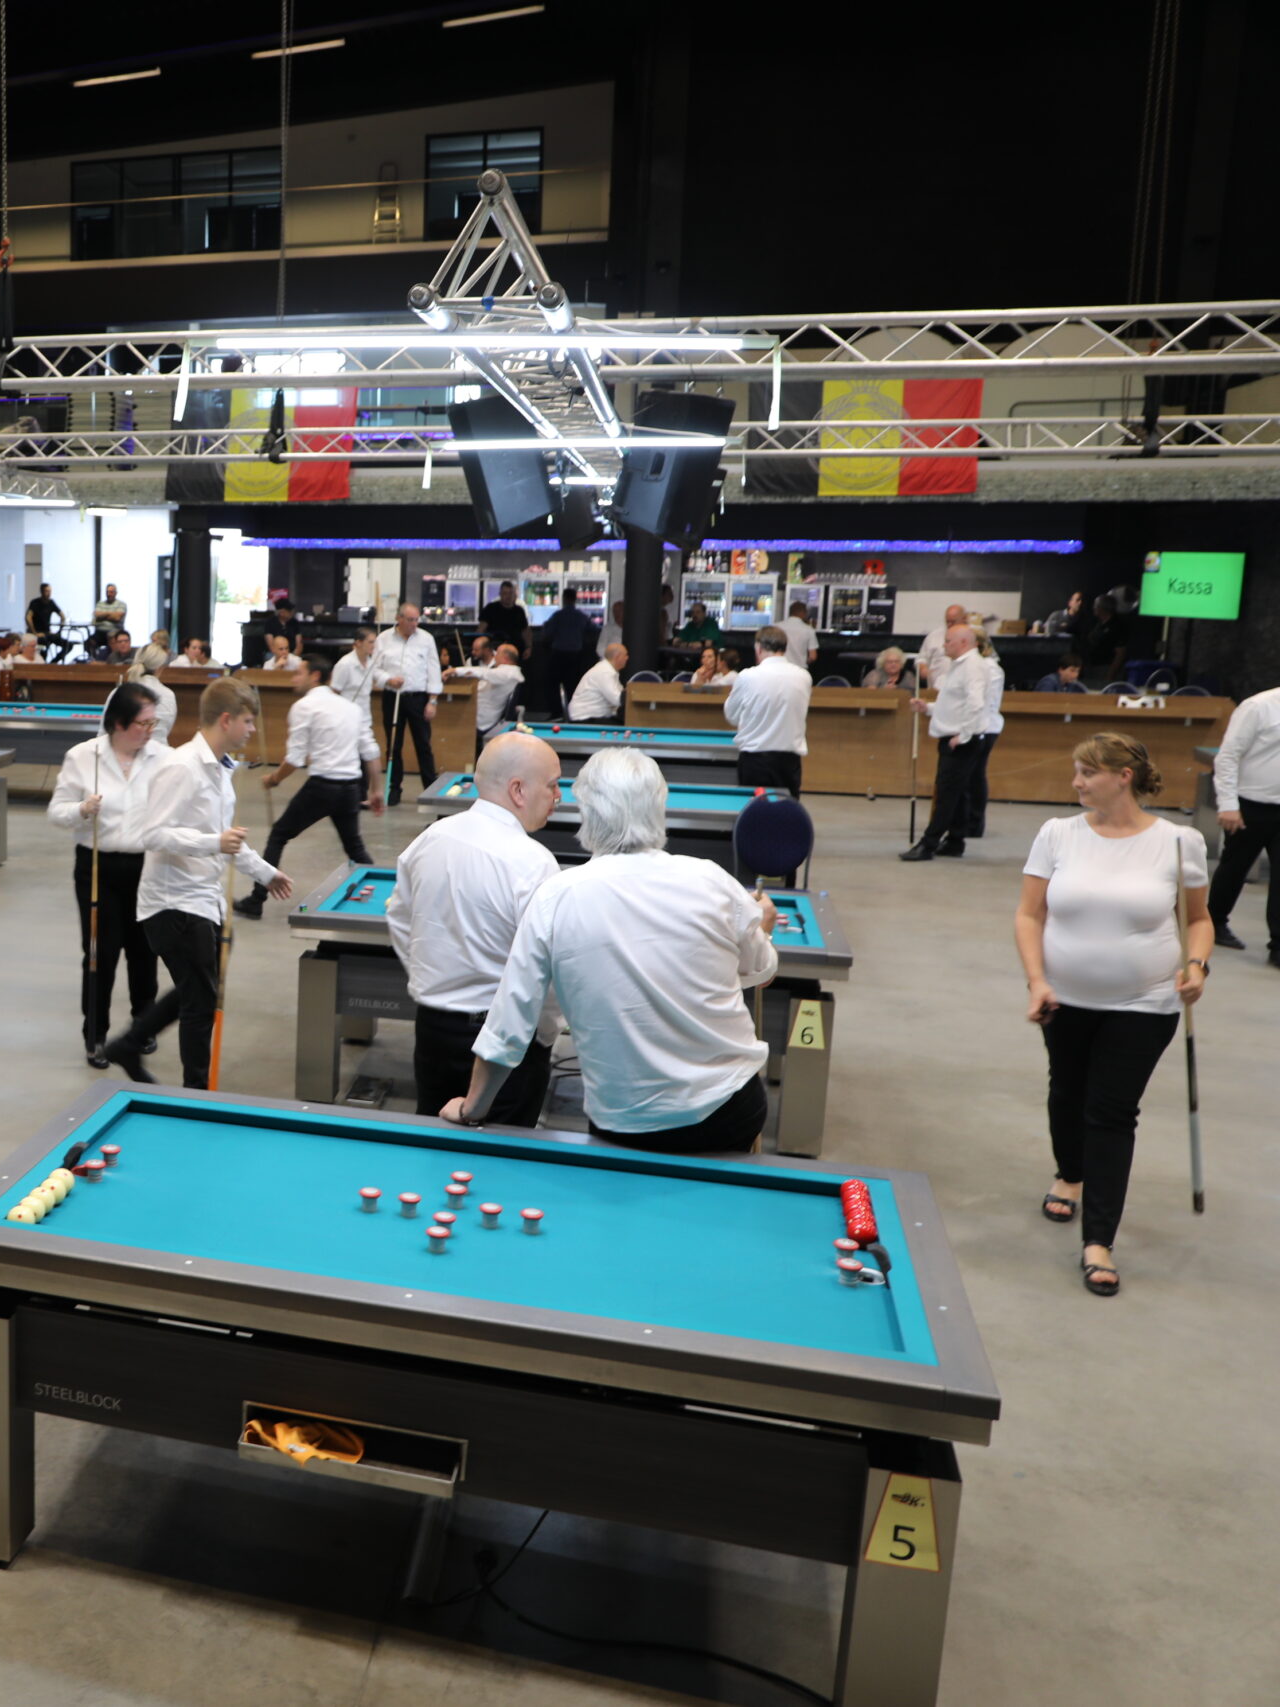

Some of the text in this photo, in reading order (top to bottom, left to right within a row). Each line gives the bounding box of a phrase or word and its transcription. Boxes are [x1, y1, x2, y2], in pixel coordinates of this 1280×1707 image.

[1168, 577, 1213, 595] Kassa
[801, 1026, 814, 1045] 6
[34, 1382, 121, 1411] STEELBLOCK
[889, 1524, 916, 1561] 5
